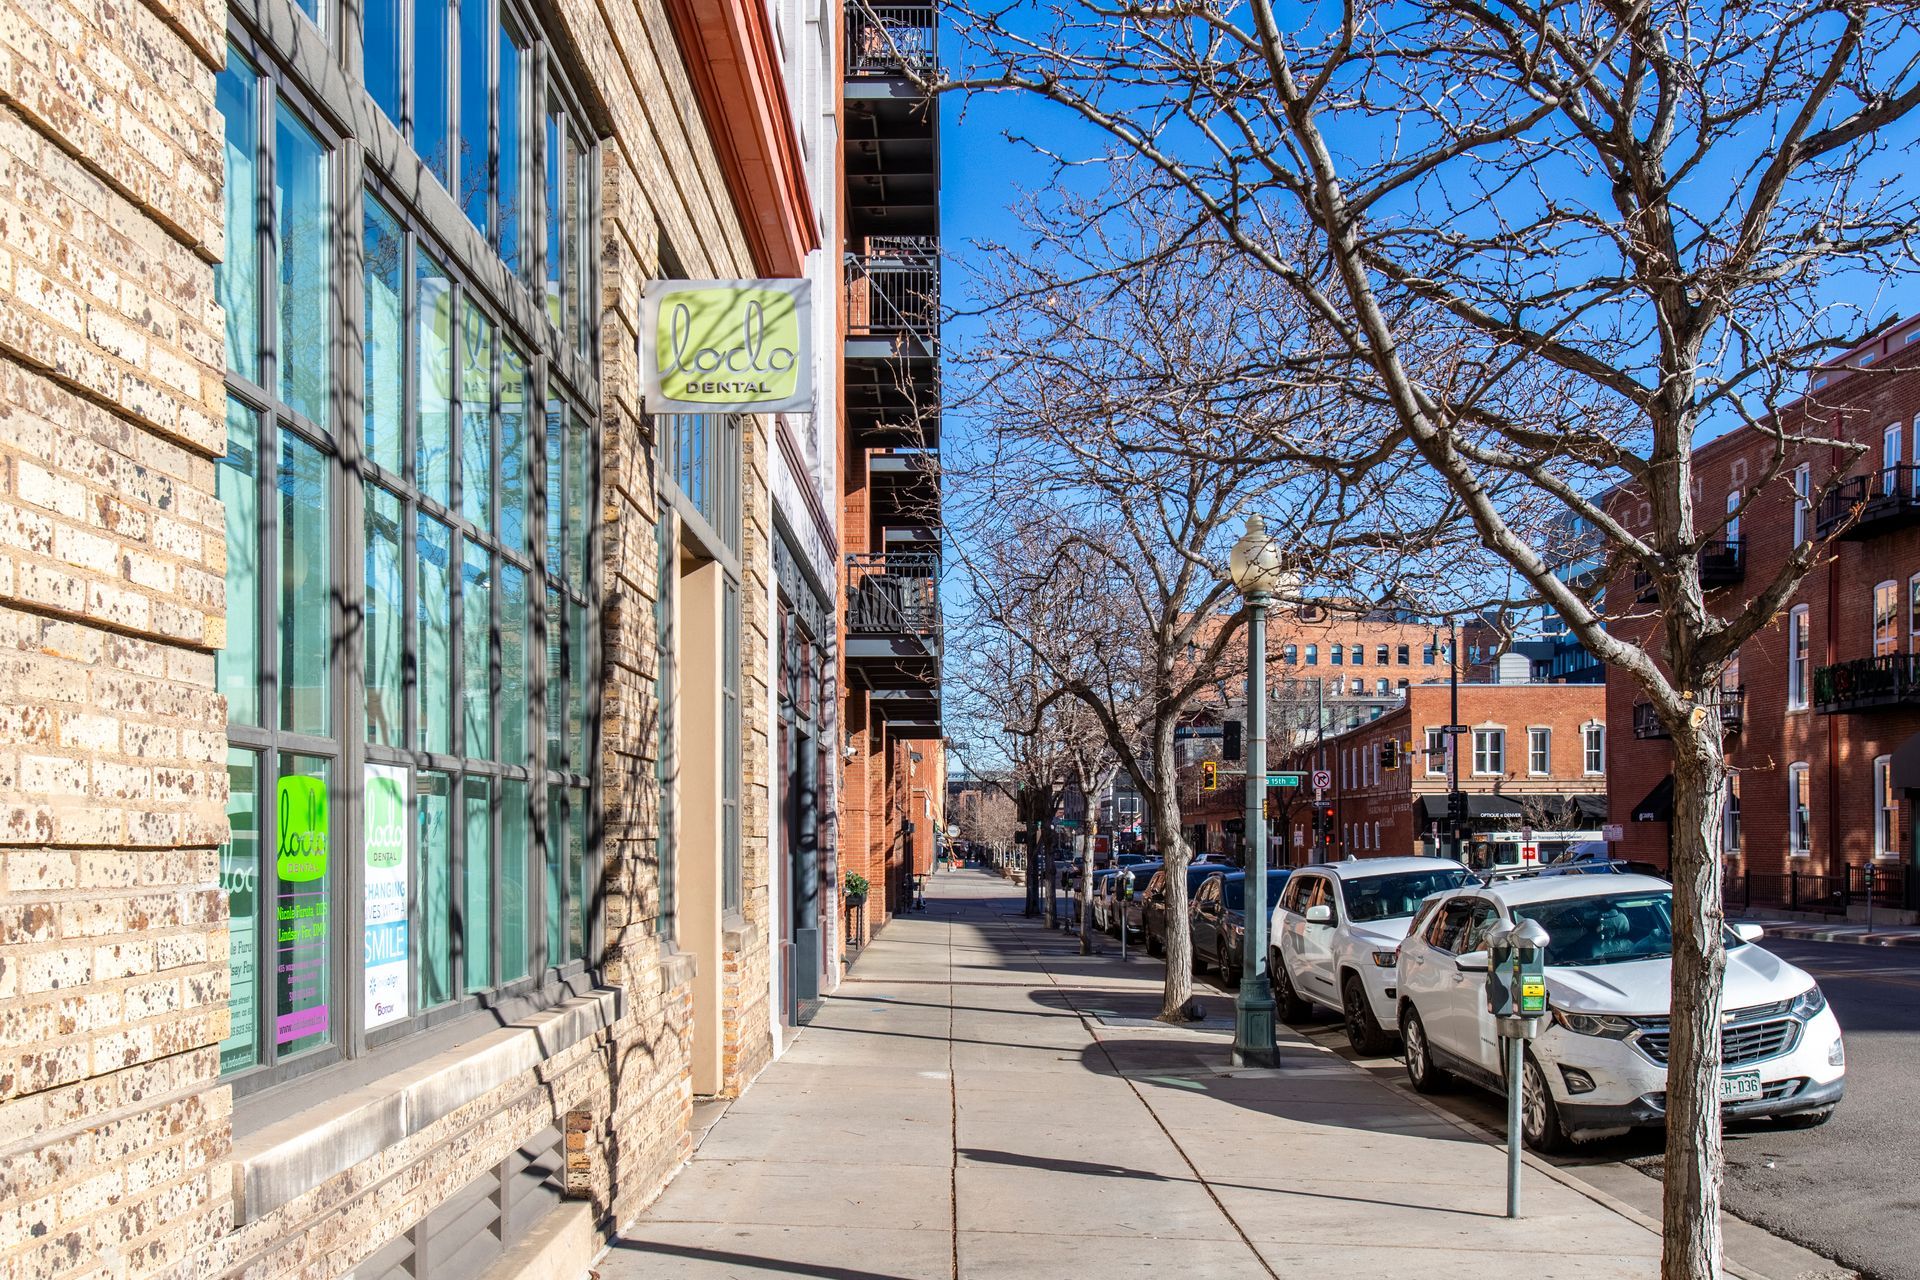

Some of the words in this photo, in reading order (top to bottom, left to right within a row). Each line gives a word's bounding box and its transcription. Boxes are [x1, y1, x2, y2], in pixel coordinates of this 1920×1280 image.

[658, 300, 799, 377] lodo
[685, 381, 772, 394] DENTAL
[373, 852, 397, 862] DENTAL
[287, 863, 320, 874] DENTAL
[238, 941, 252, 954] Furu
[365, 925, 404, 963] SMILE
[230, 963, 242, 978] say
